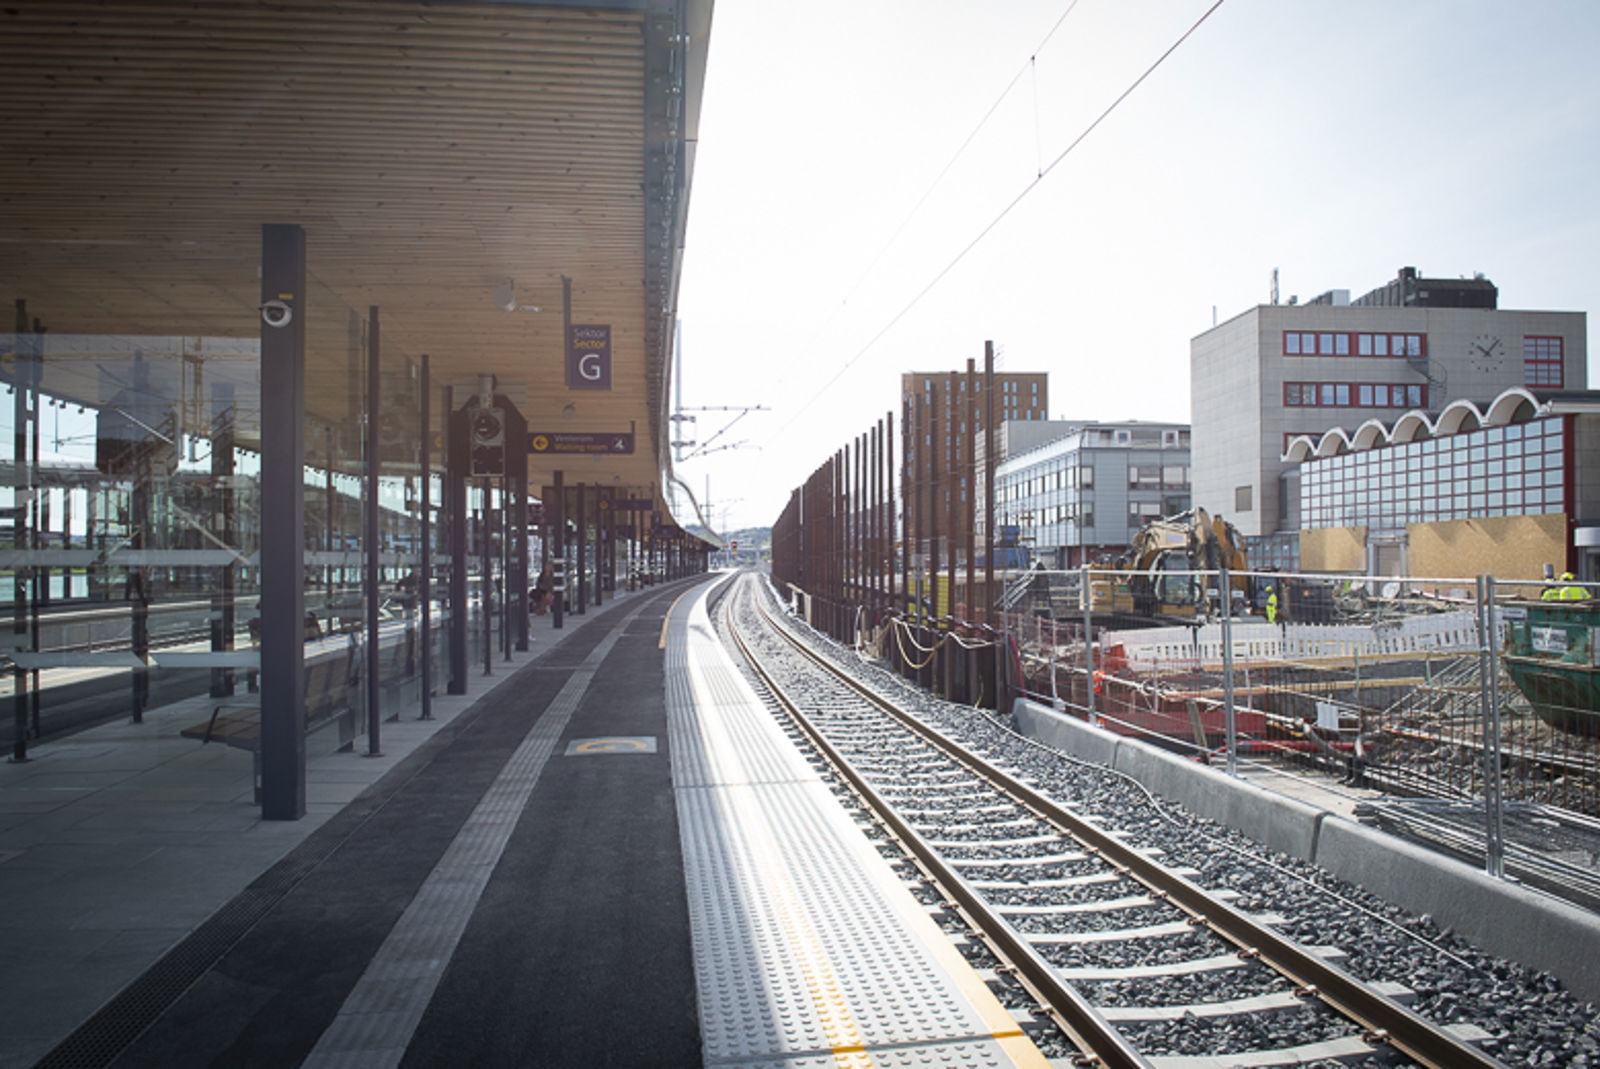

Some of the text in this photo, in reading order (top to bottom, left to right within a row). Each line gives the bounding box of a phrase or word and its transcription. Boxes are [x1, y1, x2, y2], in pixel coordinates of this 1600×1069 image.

[574, 328, 606, 337] Sektor
[574, 339, 606, 349] Sector
[579, 353, 601, 380] G
